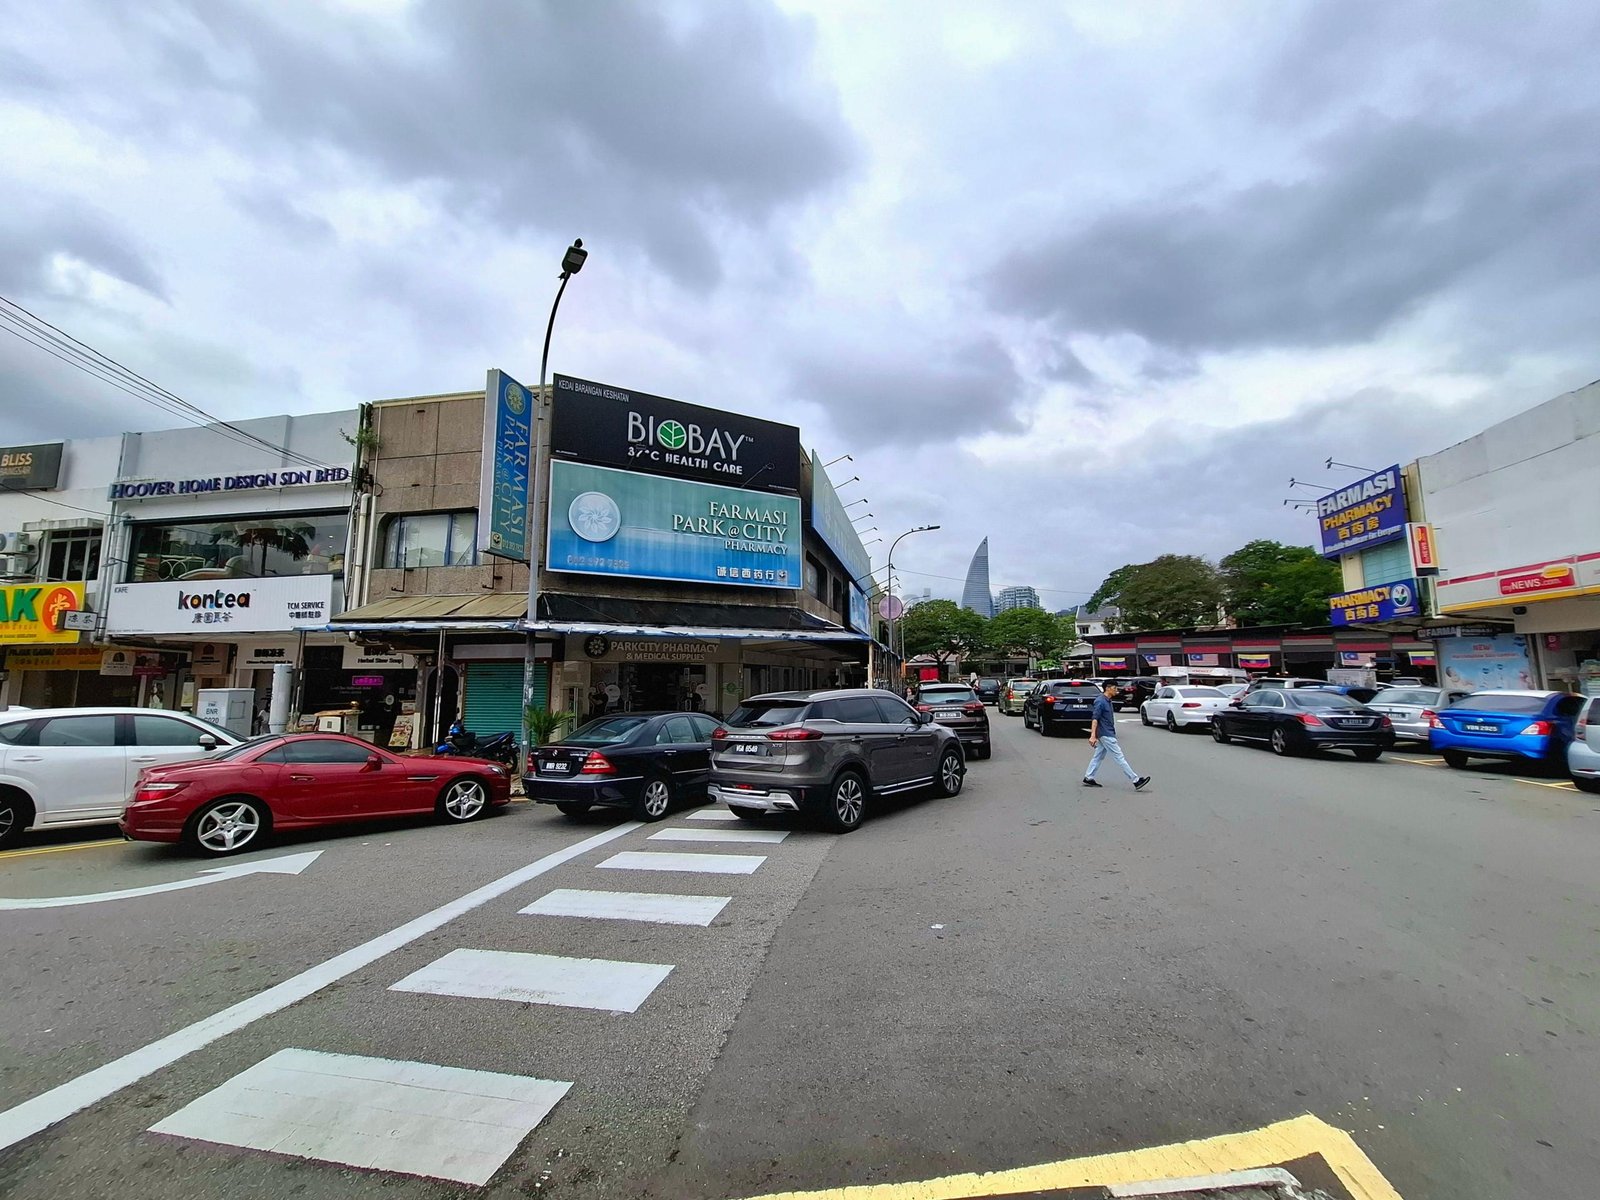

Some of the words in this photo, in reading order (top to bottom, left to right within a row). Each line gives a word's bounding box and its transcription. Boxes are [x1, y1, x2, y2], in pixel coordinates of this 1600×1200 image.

[558, 380, 574, 391] KEDAI
[574, 383, 603, 397] BARANGAN
[603, 389, 630, 402] KESIHATAN
[503, 414, 516, 467] PARK
[1, 452, 33, 467] BLISS
[665, 452, 709, 469] HEALTH
[713, 461, 743, 475] CARE
[110, 481, 176, 499] HOOVER
[178, 478, 221, 494] HOME
[223, 472, 277, 490] DESIGN
[280, 470, 311, 485] SDN
[314, 467, 349, 482] BHD
[510, 420, 529, 535] FARMASI
[1319, 470, 1396, 518] FARMASI
[500, 482, 512, 532] CITY
[709, 501, 788, 525] FARMASI
[1323, 494, 1393, 531] PHARMACY
[672, 514, 726, 536] PARK
[728, 526, 740, 538] @
[742, 523, 788, 542] CITY
[1338, 516, 1380, 540] 西药房
[724, 540, 788, 556] PHARMACY
[717, 566, 775, 580] 诚信西药行
[178, 589, 251, 610] kontea
[301, 601, 325, 609] SERVICE
[1330, 586, 1391, 609] PHARMACY
[1345, 604, 1379, 620] 西药房
[610, 641, 660, 652] PARKCITY
[662, 642, 719, 653] PHARMACY
[626, 652, 633, 660] &
[634, 652, 670, 660] MEDICAL
